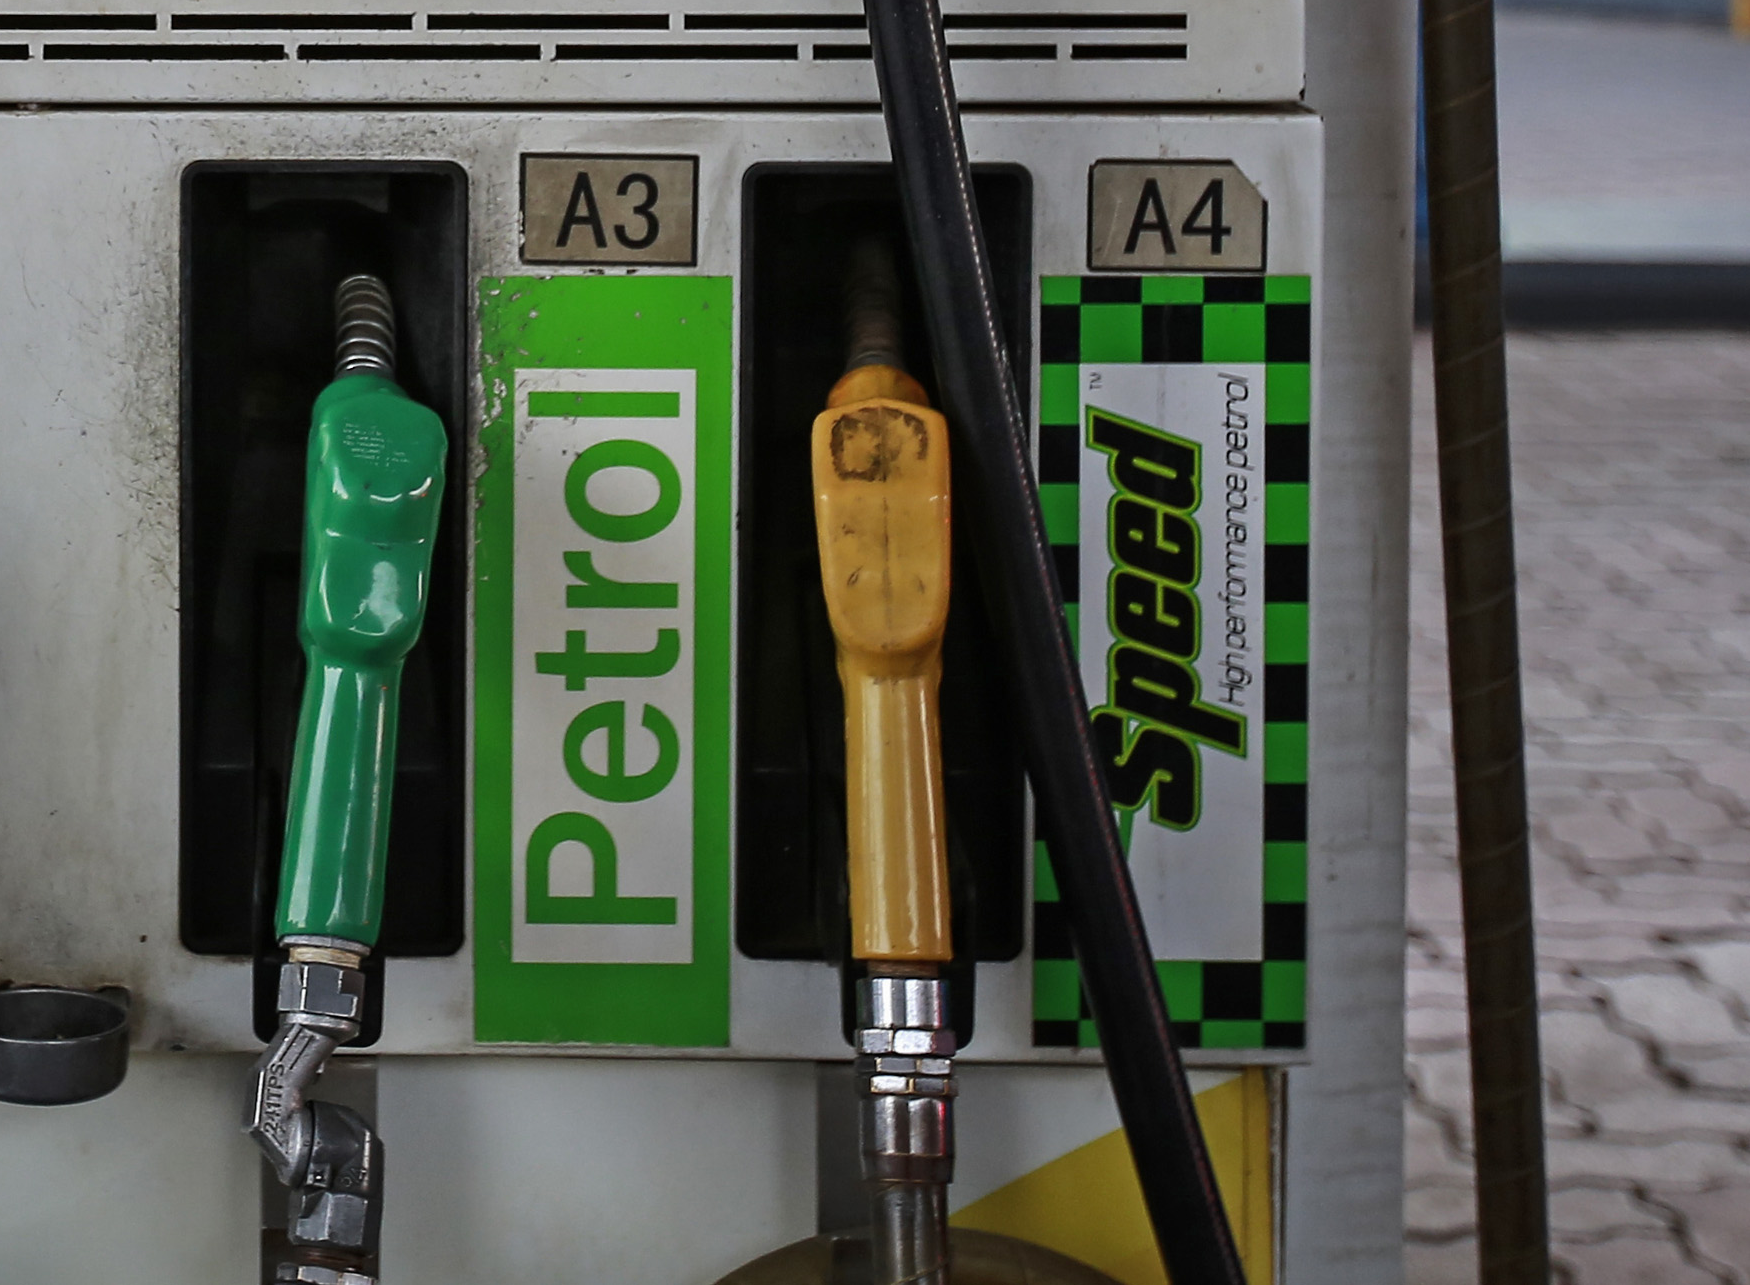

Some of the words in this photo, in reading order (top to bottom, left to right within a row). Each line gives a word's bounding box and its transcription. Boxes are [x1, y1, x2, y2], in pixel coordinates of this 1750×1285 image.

[556, 173, 661, 250] A3
[1123, 177, 1233, 256] A4
[1217, 372, 1254, 471] petrol
[1218, 475, 1252, 652] performance
[525, 390, 682, 926] Petrol
[1217, 653, 1252, 707] High
